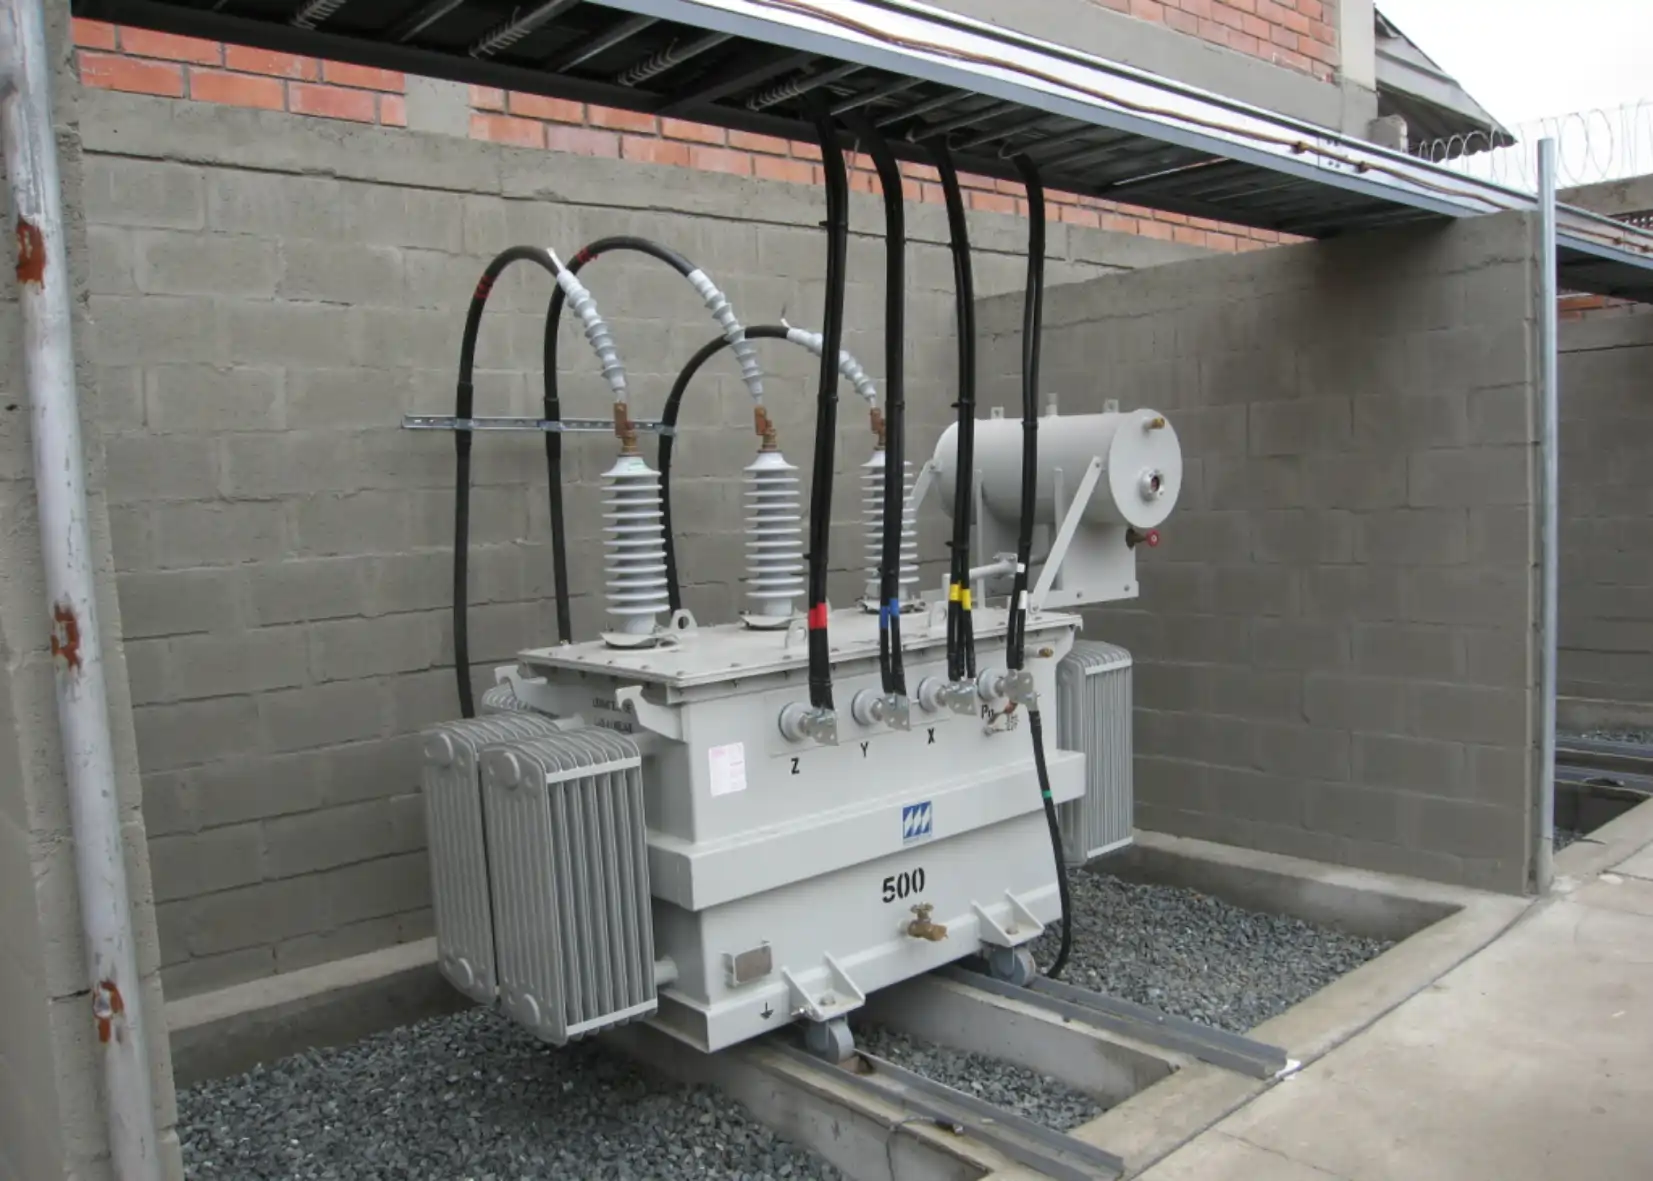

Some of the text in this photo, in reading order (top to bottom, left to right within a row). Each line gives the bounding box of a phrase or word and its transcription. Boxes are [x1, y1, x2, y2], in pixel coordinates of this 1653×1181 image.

[927, 728, 935, 745] X
[860, 742, 869, 757] Y
[791, 758, 800, 775] Z
[882, 867, 925, 903] 500
